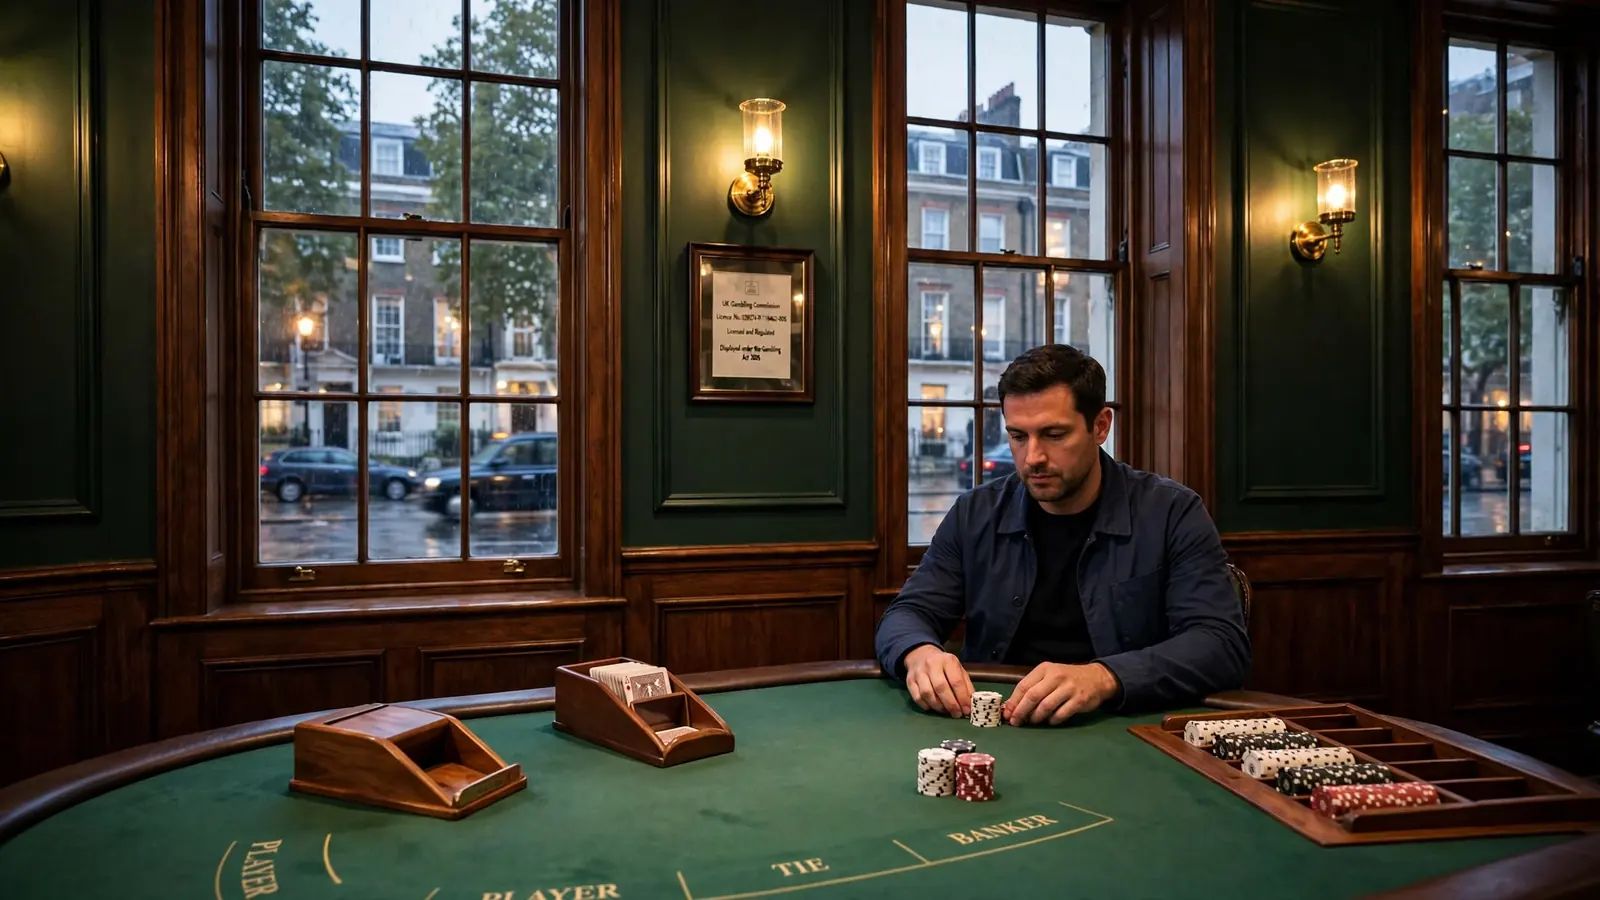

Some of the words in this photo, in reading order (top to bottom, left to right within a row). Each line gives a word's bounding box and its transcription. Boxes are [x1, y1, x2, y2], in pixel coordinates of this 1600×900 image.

[730, 300, 753, 310] Gambling
[754, 328, 775, 336] Regulated
[720, 344, 741, 352] Displayed
[761, 345, 781, 355] Gambling
[946, 814, 1059, 845] BANKER
[241, 839, 283, 899] PLAYER
[771, 857, 830, 877] TIE
